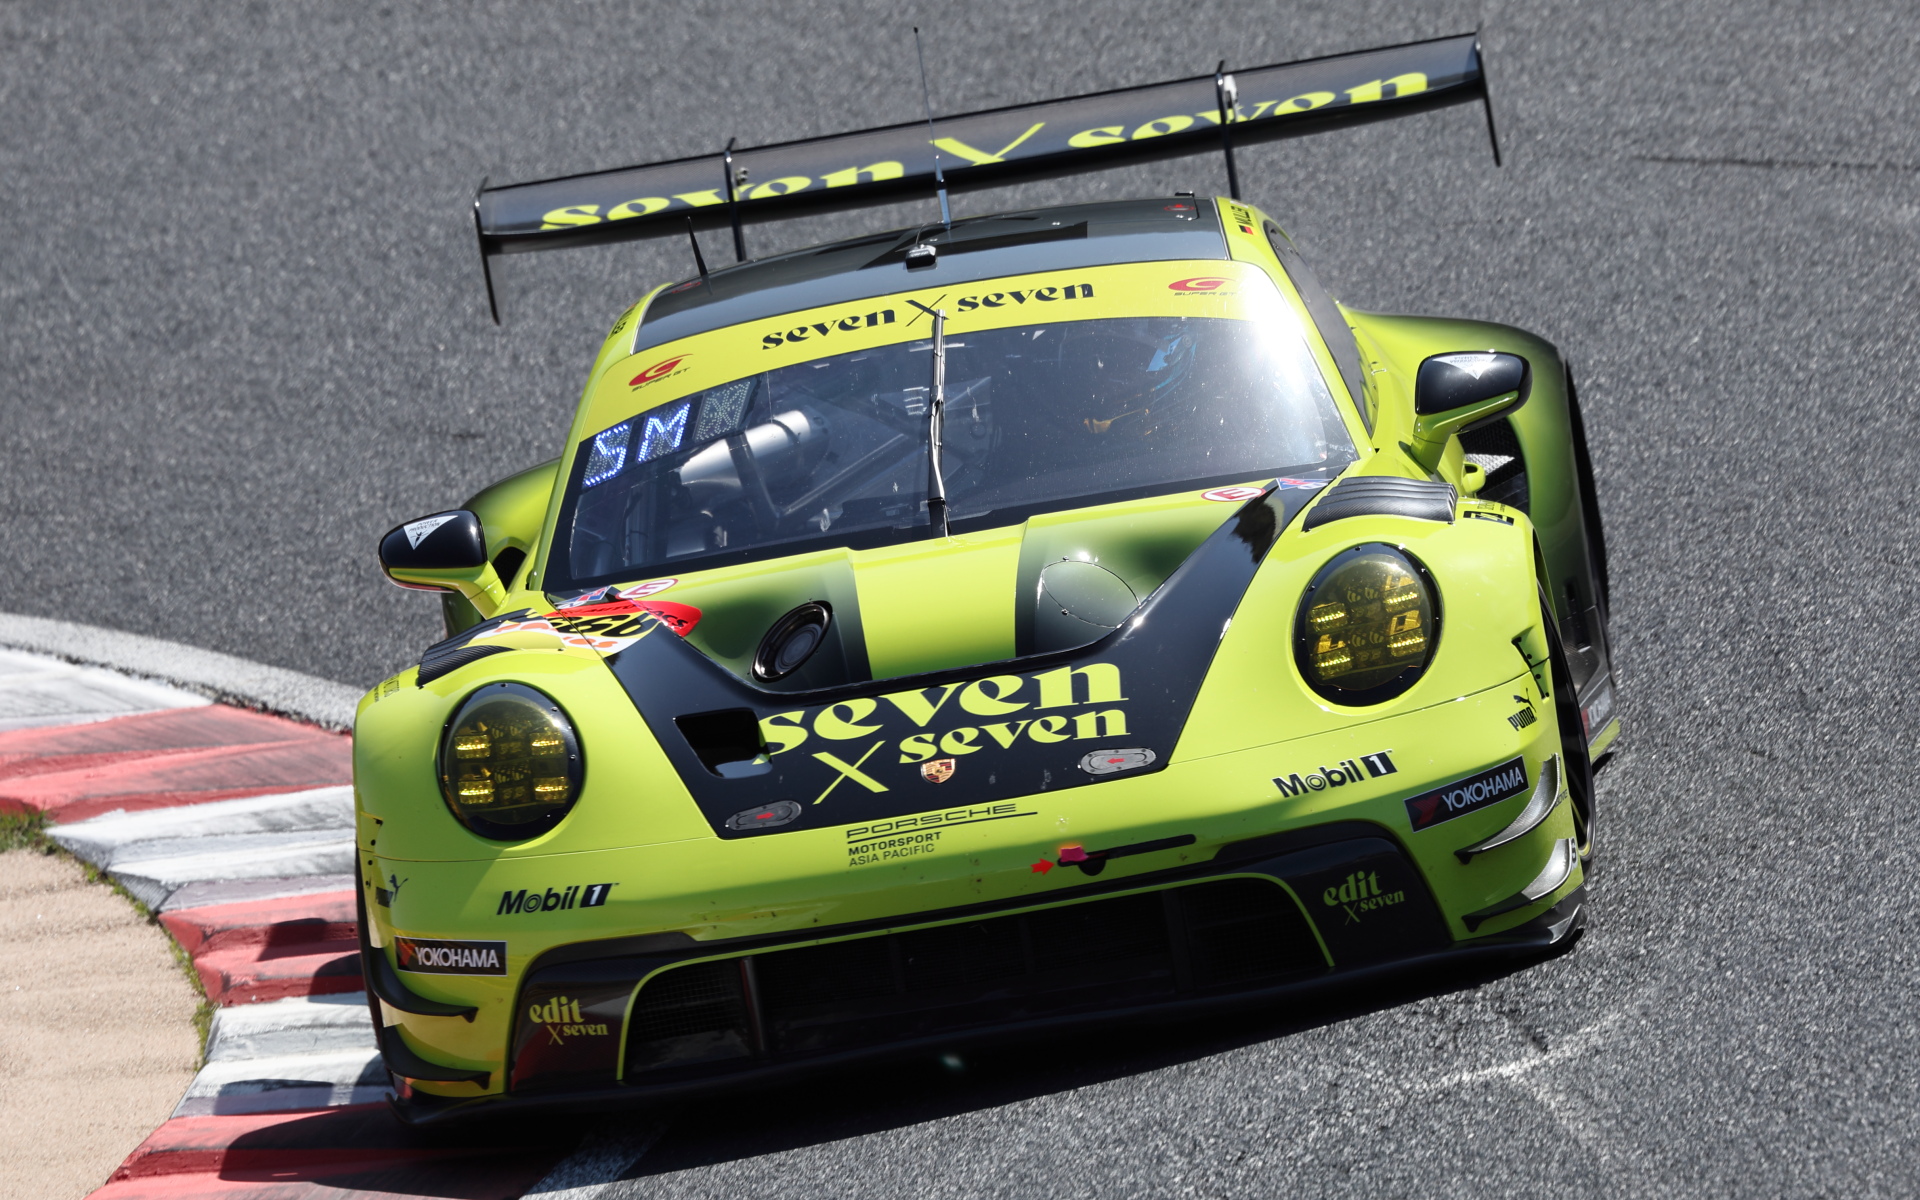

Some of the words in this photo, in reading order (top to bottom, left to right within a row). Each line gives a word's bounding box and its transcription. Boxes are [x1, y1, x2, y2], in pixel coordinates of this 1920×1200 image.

[763, 308, 897, 350] seven
[905, 293, 950, 327] X
[957, 282, 1096, 312] seven
[752, 662, 1129, 766] seven
[811, 740, 890, 806] X
[899, 709, 1131, 764] seven
[1272, 758, 1365, 798] Mobil
[1441, 766, 1524, 812] YOKOHAMA
[846, 803, 1017, 839] PORSCHE
[848, 831, 942, 857] MOTORSPORT
[848, 853, 880, 867] ASIA
[883, 843, 935, 860] PACIFIC
[496, 885, 580, 916] Mobil
[1323, 870, 1382, 907] edit
[1360, 890, 1405, 912] seven
[415, 946, 500, 968] YOKOHAMA
[529, 995, 585, 1024] edit
[562, 1023, 609, 1037] seven
